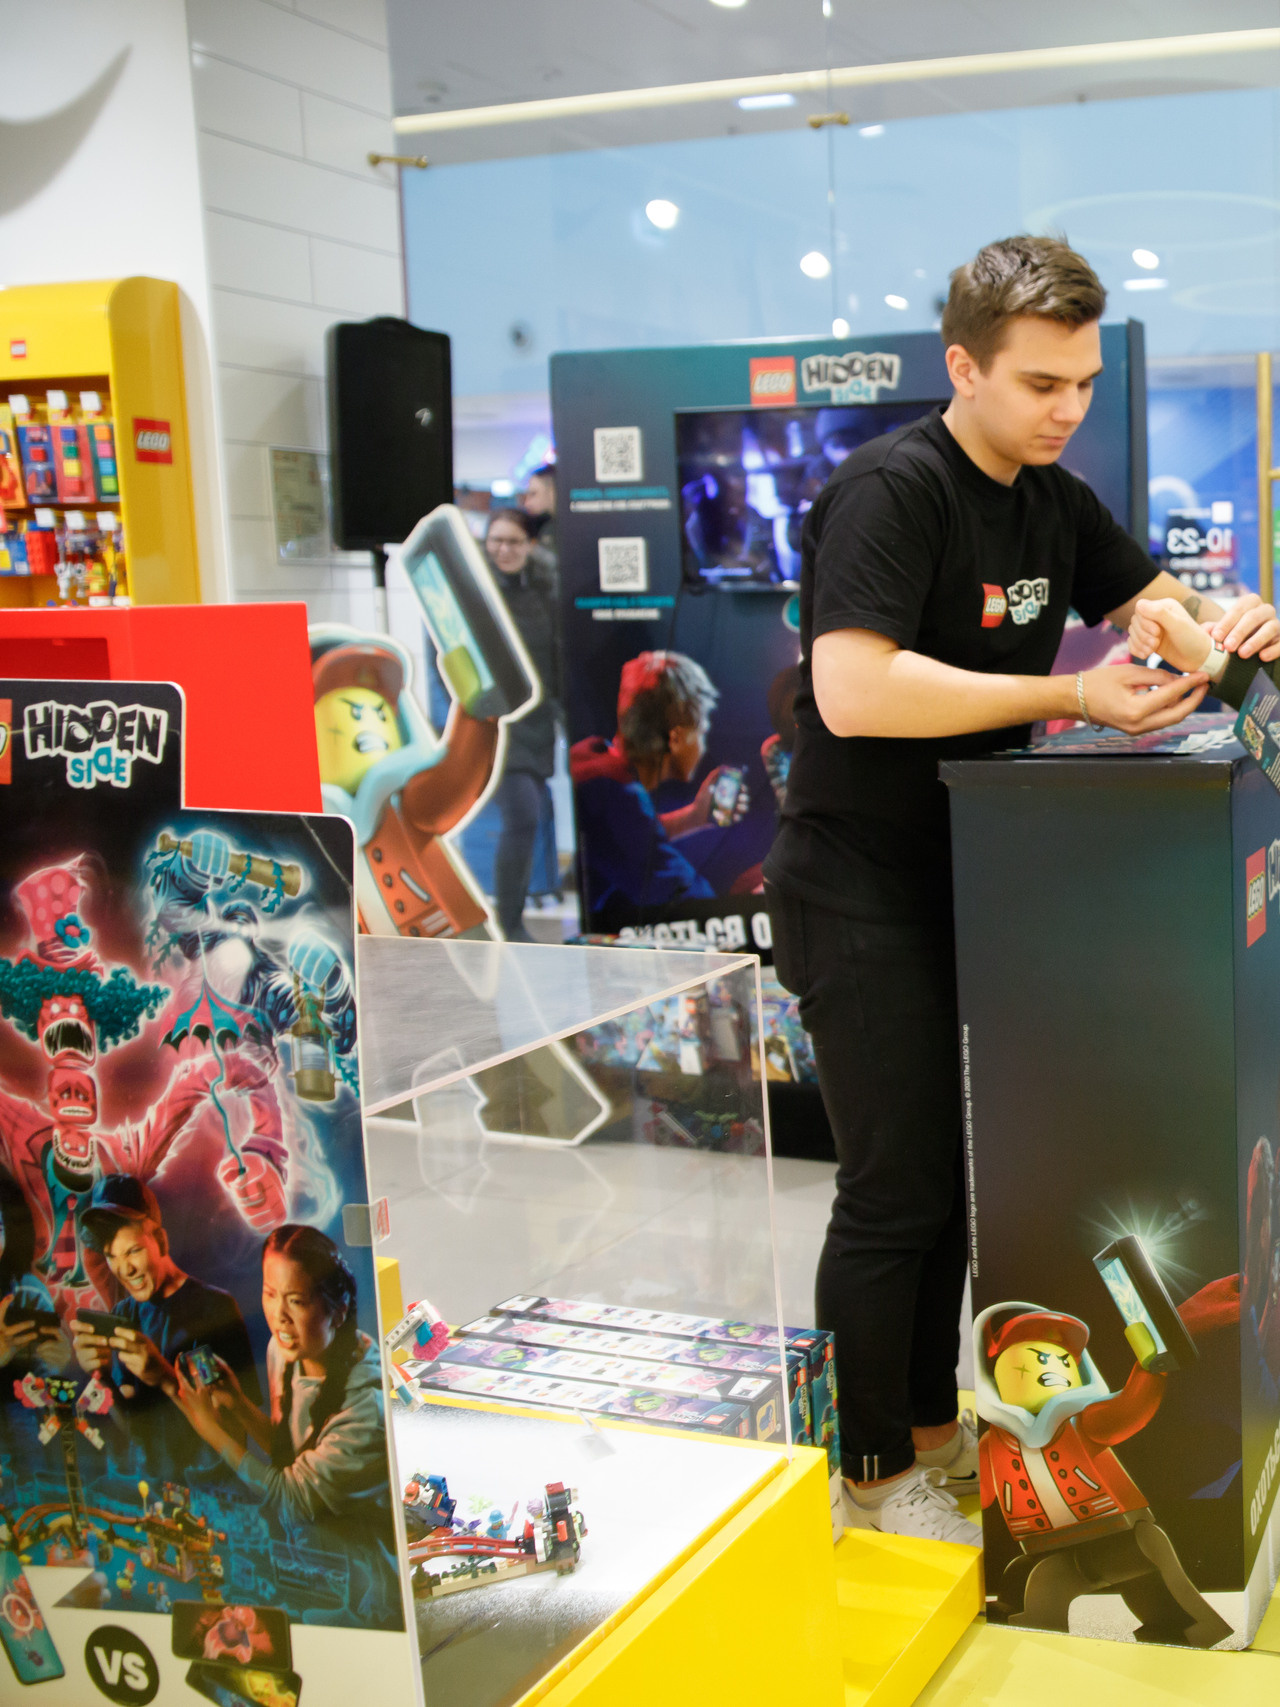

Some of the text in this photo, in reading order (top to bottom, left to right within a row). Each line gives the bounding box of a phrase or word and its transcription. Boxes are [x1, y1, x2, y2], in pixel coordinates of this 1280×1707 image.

[753, 372, 793, 394] LEGO
[804, 355, 897, 387] HIDDEN
[137, 430, 169, 452] LEGO
[986, 597, 1005, 613] LEGO
[26, 702, 165, 761] HIDDEN
[69, 746, 129, 784] SIDE
[1248, 873, 1264, 917] LEGO
[93, 1645, 150, 1692] VS
